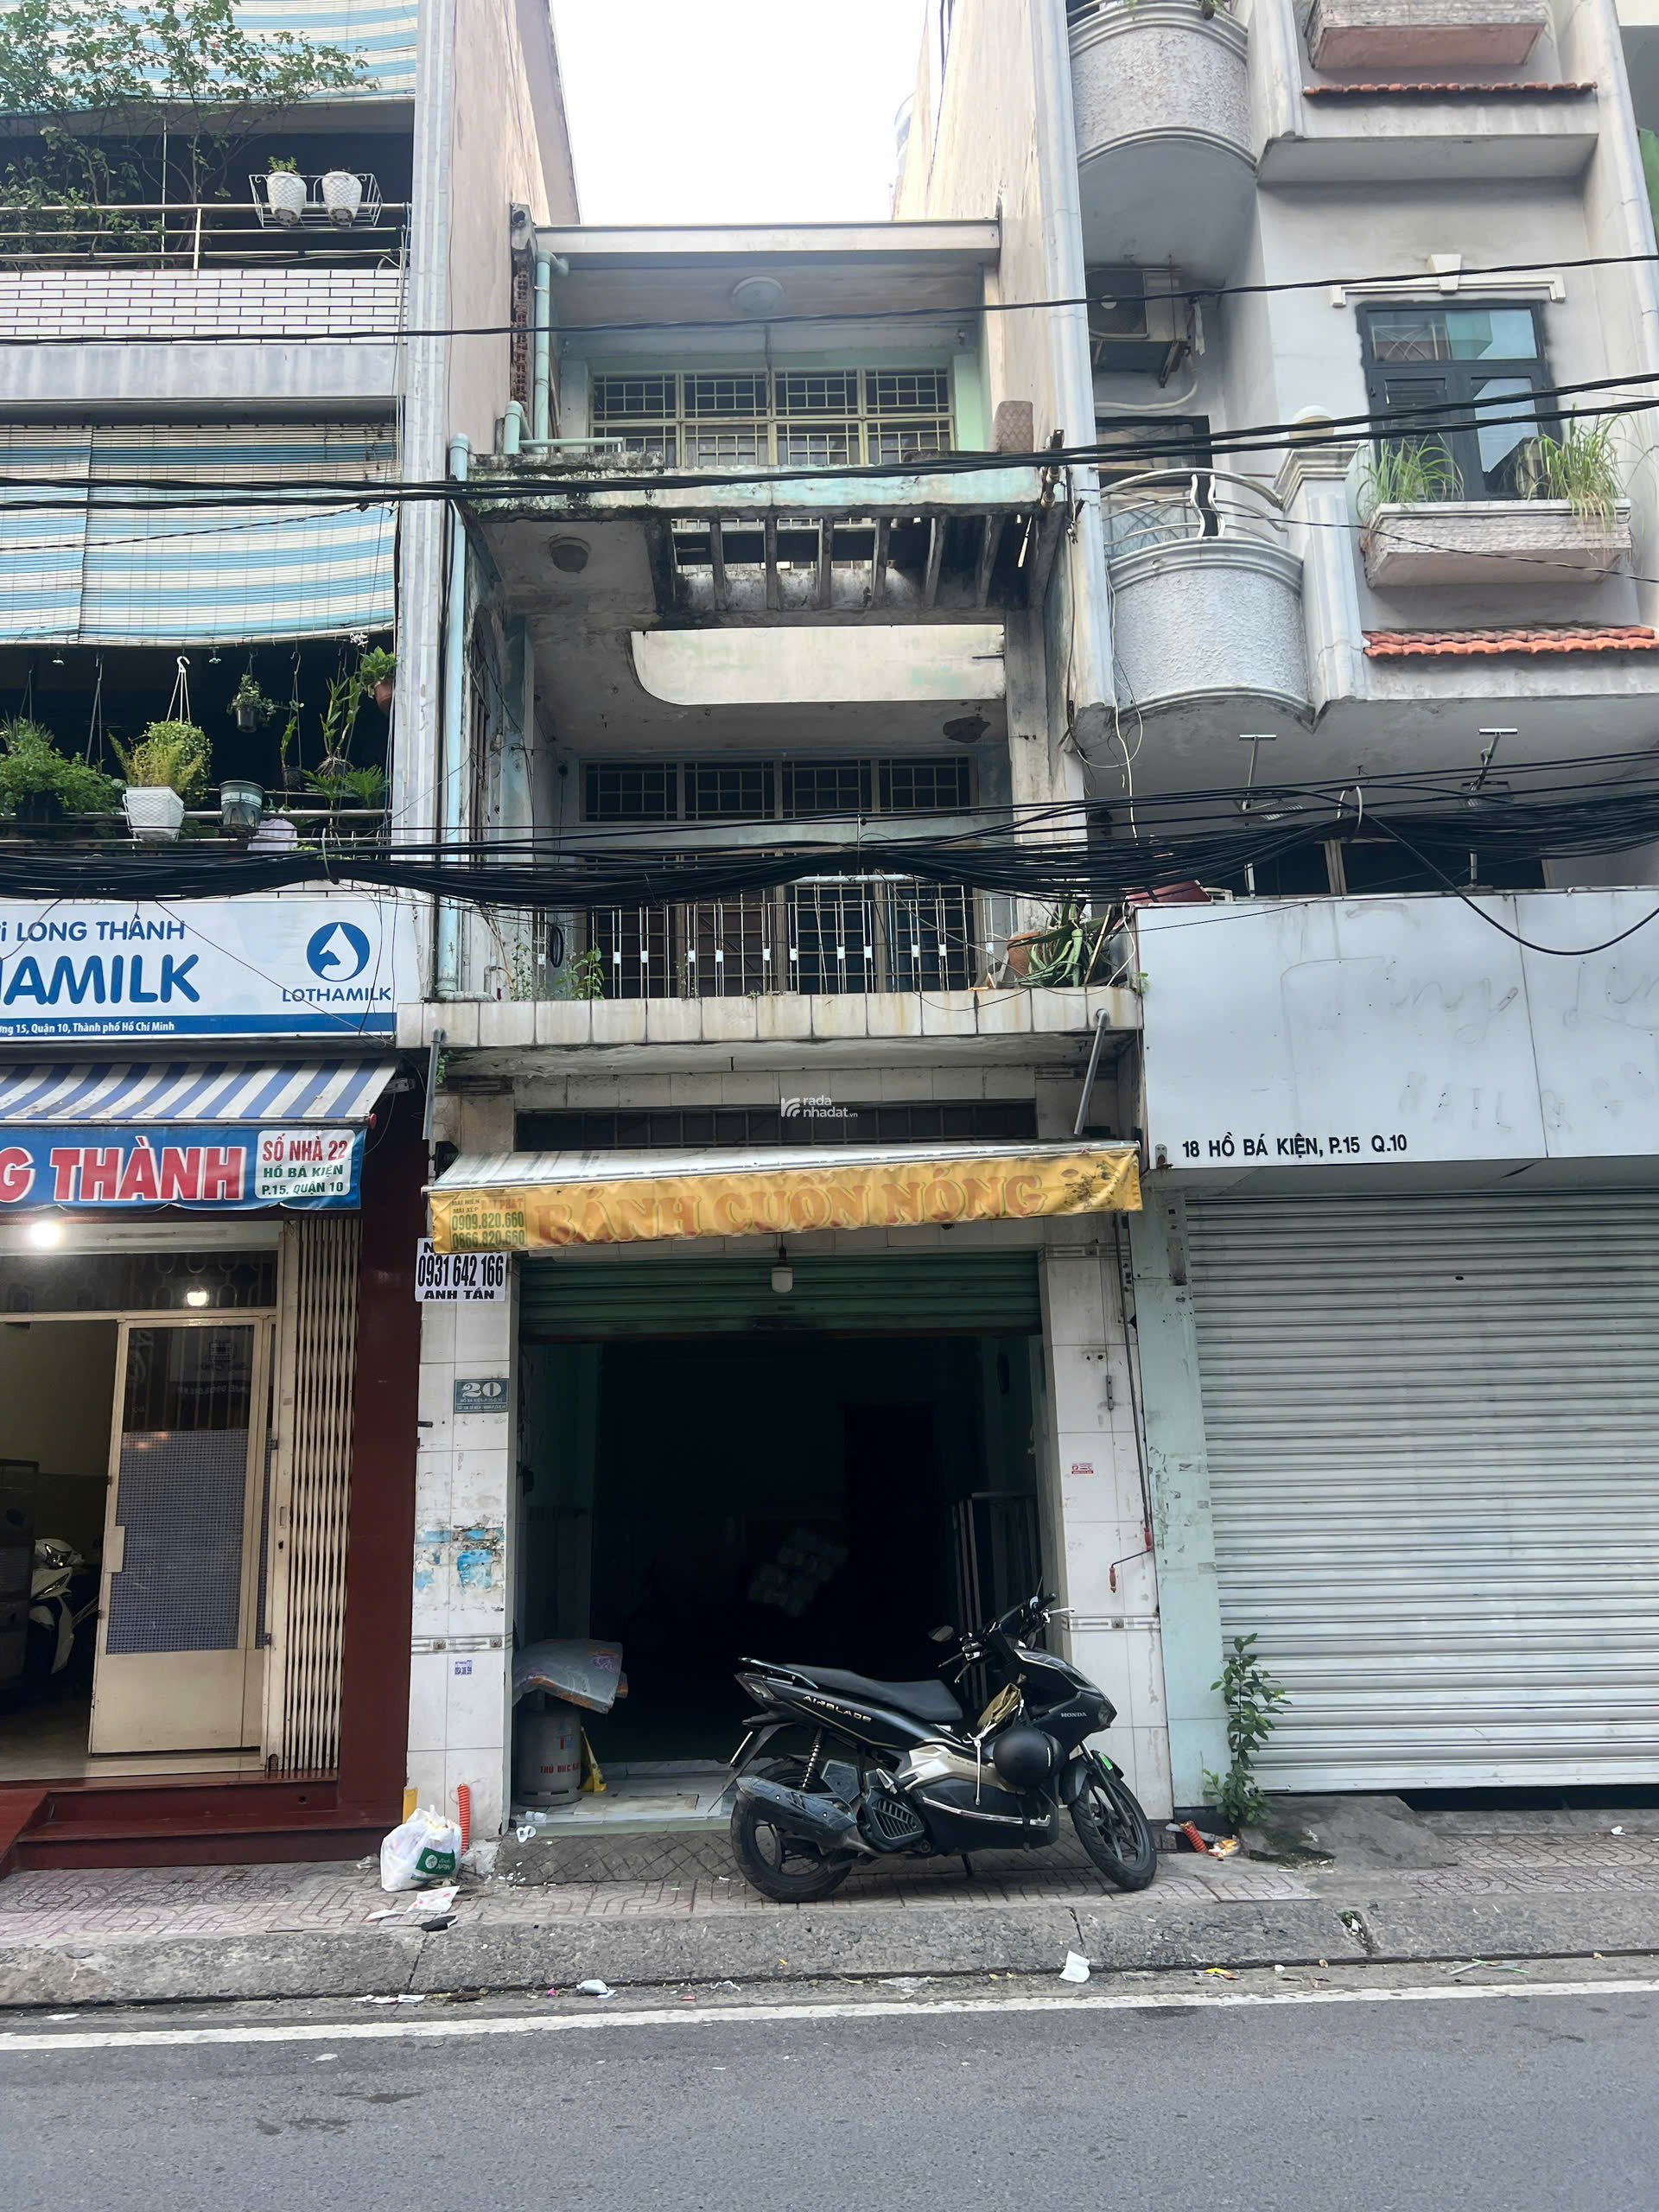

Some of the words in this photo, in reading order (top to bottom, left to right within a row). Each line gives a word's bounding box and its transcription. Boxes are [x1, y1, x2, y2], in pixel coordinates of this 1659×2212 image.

[17, 921, 87, 942] LONG
[96, 913, 185, 941] THÀNH
[0, 954, 200, 1006] AMILK
[283, 987, 391, 1002] LOTHAMILK
[16, 1023, 30, 1034] 15,
[31, 1023, 55, 1035] Quận
[57, 1022, 71, 1034] 10,
[73, 1022, 100, 1033] Thành
[102, 1020, 121, 1034] phố
[136, 1021, 150, 1032] Chí
[151, 1020, 175, 1031] Minh
[263, 1133, 285, 1162] SỐ
[289, 1135, 324, 1161] NHÀ
[327, 1140, 349, 1161] 22
[1182, 1140, 1200, 1158] 18
[1208, 1132, 1235, 1157] HỒ
[1243, 1134, 1268, 1156] BÁ
[1276, 1133, 1324, 1158] KIỆN,
[1328, 1136, 1361, 1154] P.15
[1370, 1134, 1408, 1153] Q.10
[49, 1135, 247, 1201] THÀNH
[287, 1165, 308, 1178] BÁ
[312, 1164, 344, 1178] KIỆN
[294, 1180, 326, 1195] QUẬN
[329, 1181, 344, 1192] 10
[534, 1187, 702, 1245] BÁNH
[880, 1167, 1048, 1225] NÓNG
[451, 1211, 524, 1231] 0909.820.660
[452, 1230, 525, 1249] 0866.820.660
[417, 1255, 449, 1287] 0931
[452, 1255, 477, 1287] 642
[480, 1255, 504, 1287] 166
[423, 1290, 458, 1300] ANH
[461, 1382, 502, 1398] 20
